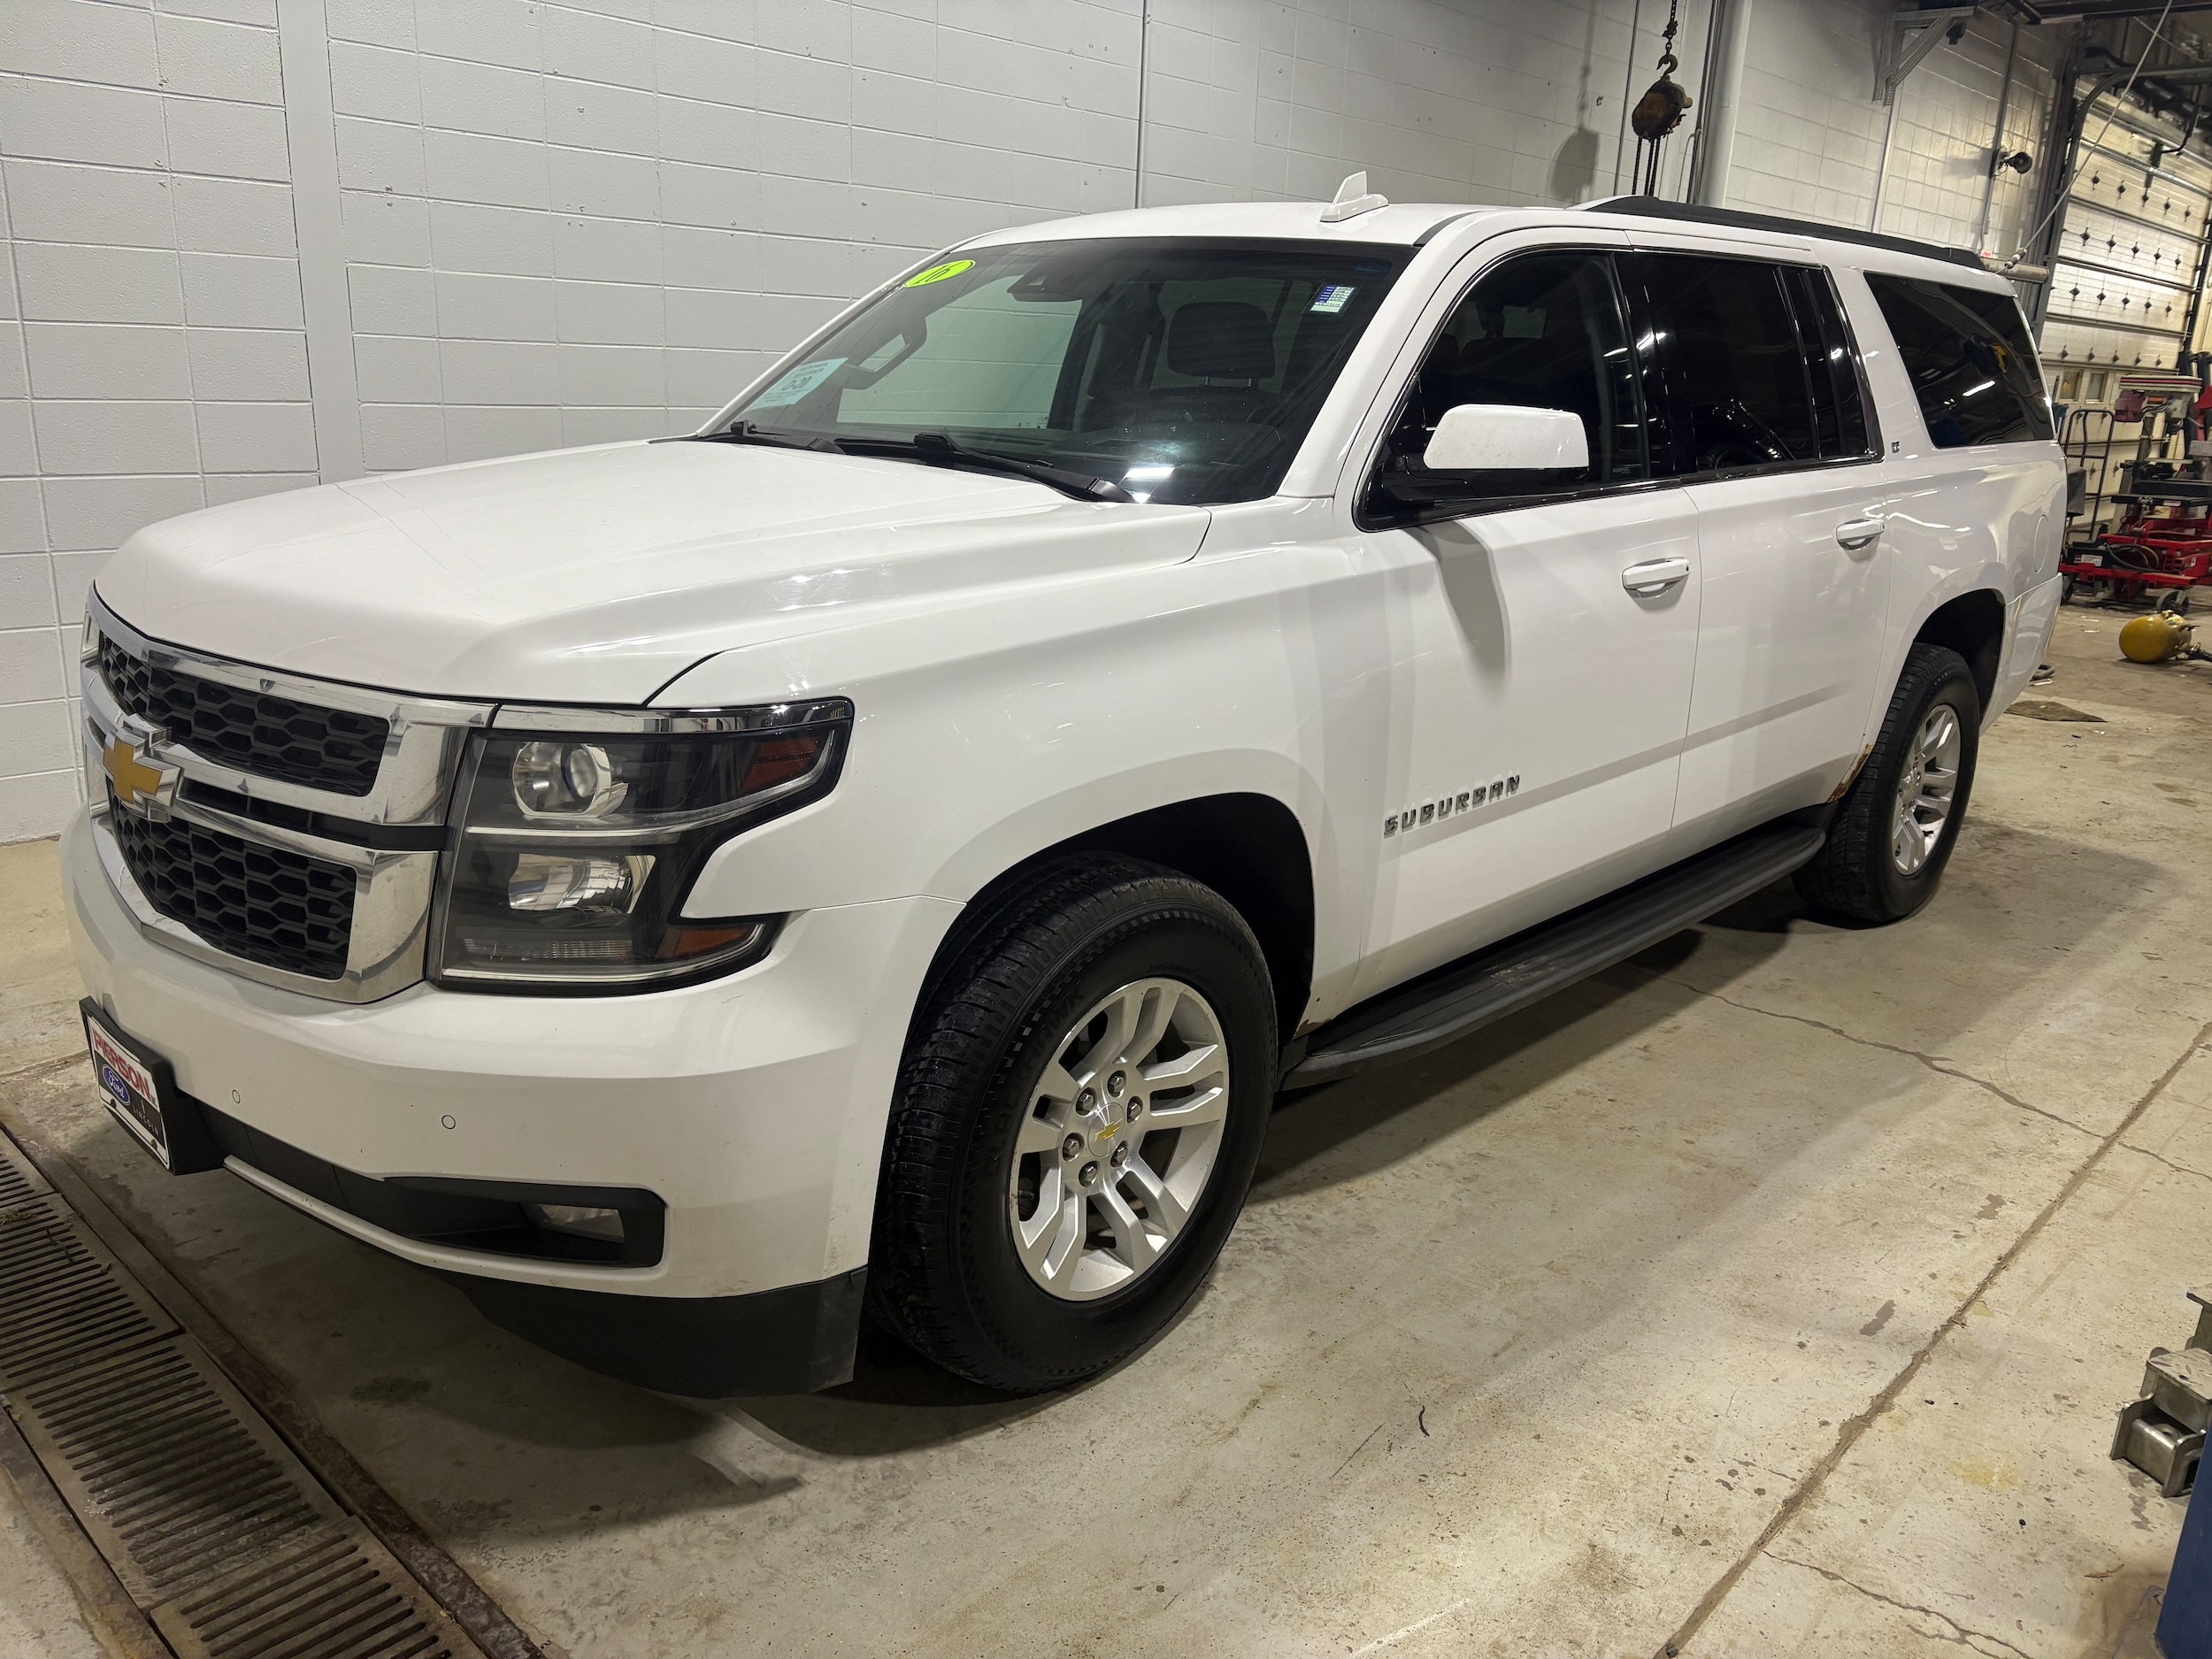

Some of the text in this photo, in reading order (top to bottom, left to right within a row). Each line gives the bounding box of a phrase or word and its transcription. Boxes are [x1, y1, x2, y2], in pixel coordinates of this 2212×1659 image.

[1384, 775, 1520, 838] SUBURBAN
[93, 1029, 150, 1100] PIERSON
[107, 1071, 125, 1099] Ford
[133, 1107, 158, 1136] LINCOLN
